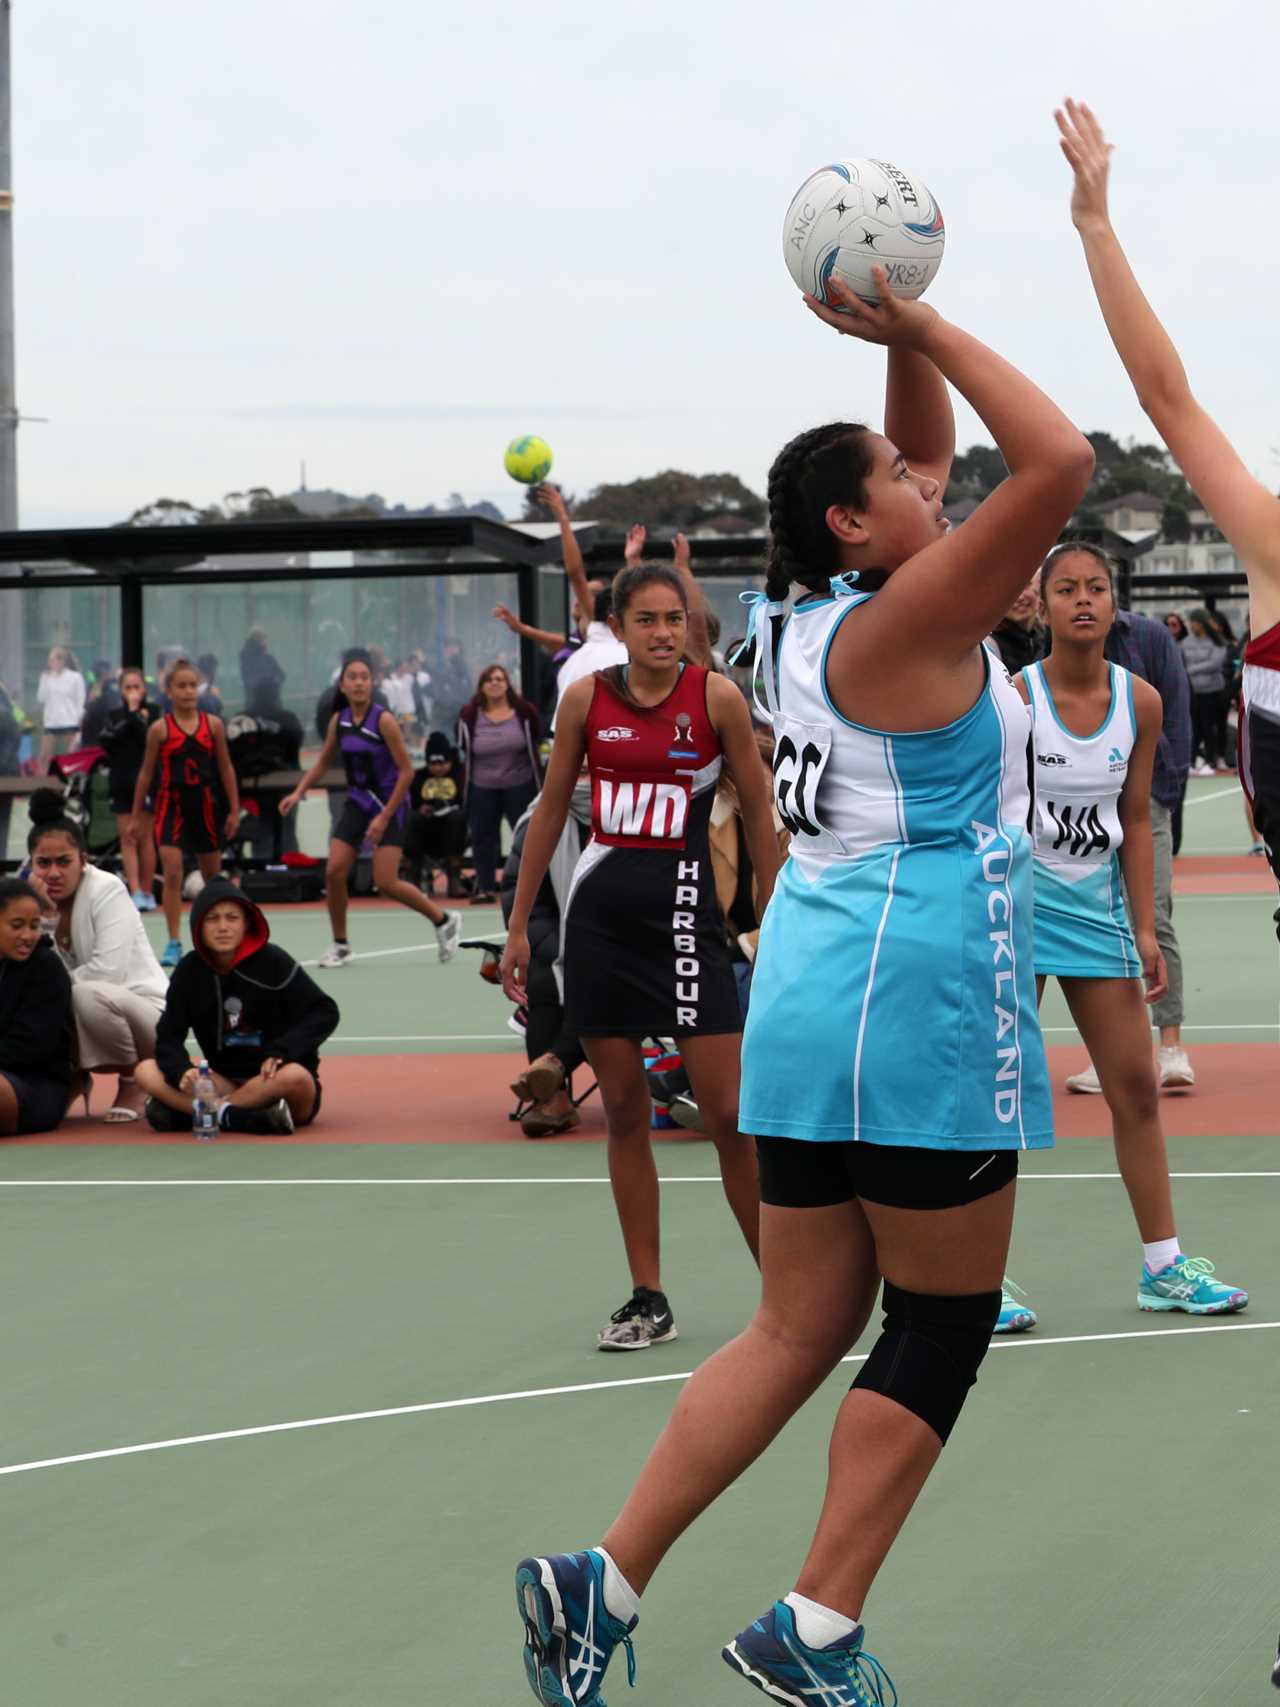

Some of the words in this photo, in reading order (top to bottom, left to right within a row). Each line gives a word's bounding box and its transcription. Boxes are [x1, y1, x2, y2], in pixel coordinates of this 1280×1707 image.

[790, 203, 816, 251] ANC
[600, 779, 688, 839] WD
[672, 860, 700, 1027] HARBOUR
[971, 820, 1018, 1124] AUCKLAND
